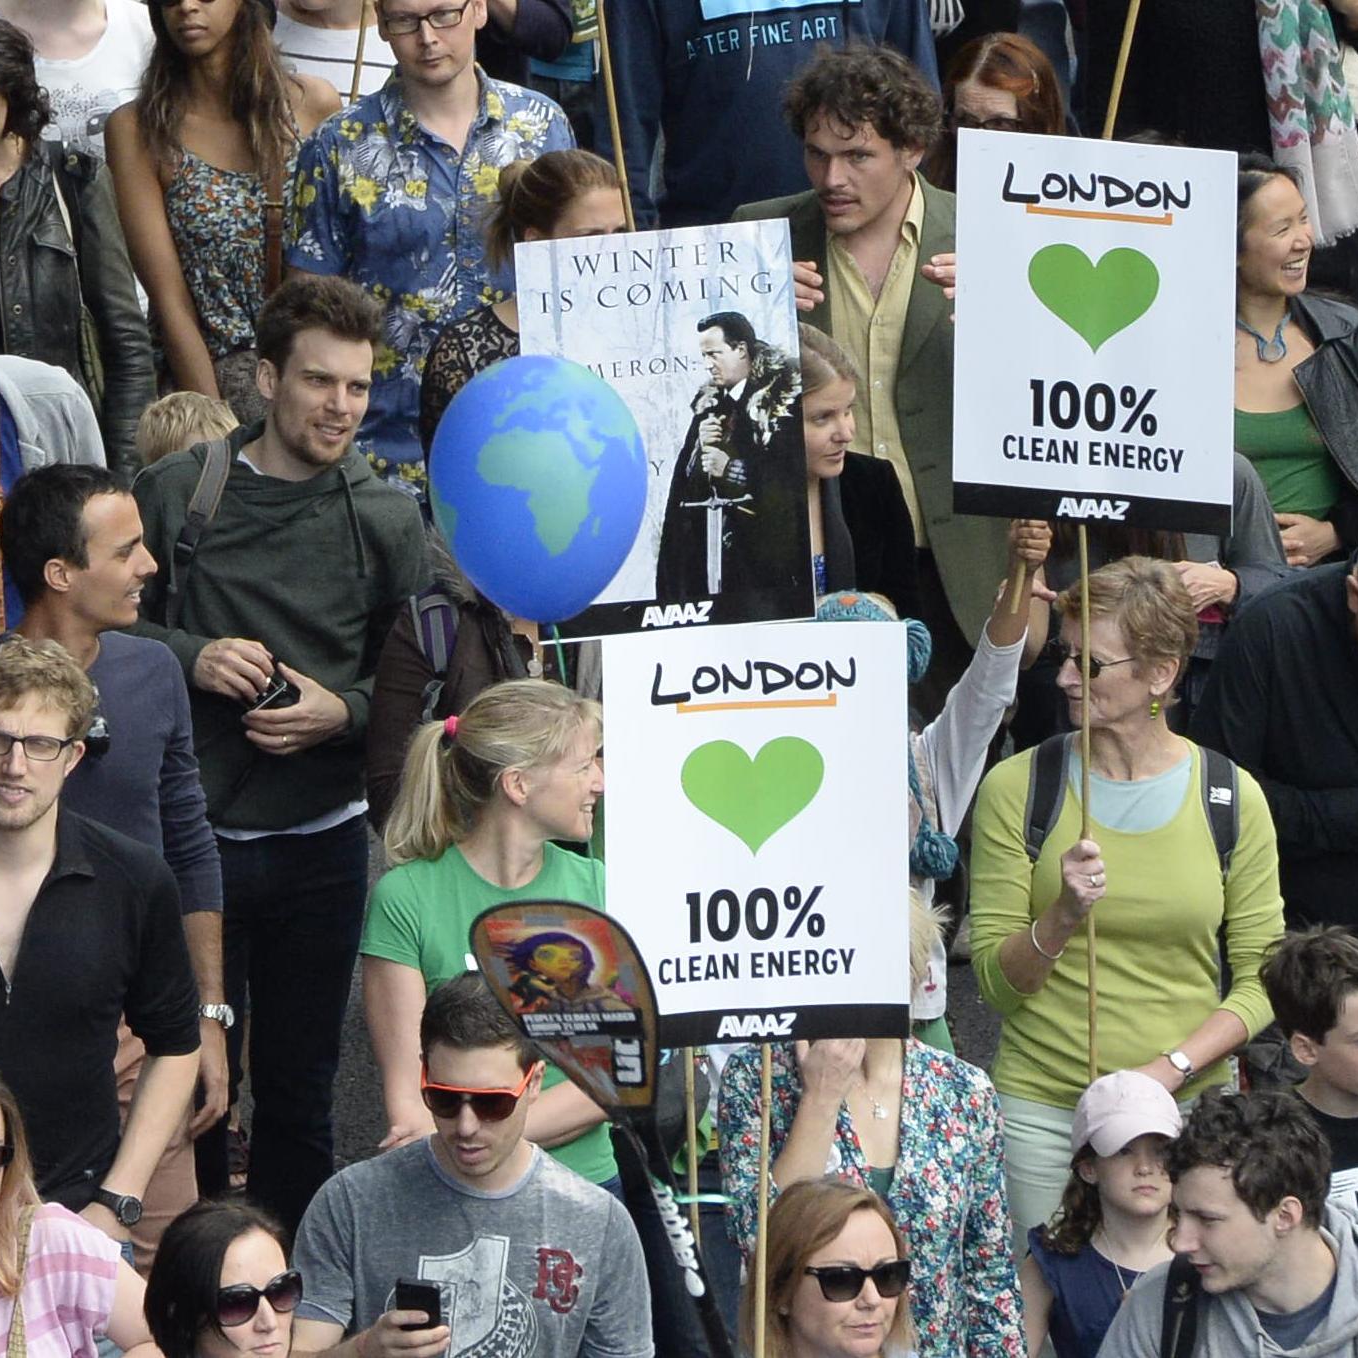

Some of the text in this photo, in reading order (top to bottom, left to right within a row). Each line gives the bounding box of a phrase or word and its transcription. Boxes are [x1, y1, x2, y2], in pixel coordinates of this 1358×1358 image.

[749, 21, 793, 47] FINE
[801, 16, 838, 41] ART
[1002, 162, 1191, 210] LONDON
[572, 241, 738, 277] WINTER
[541, 290, 573, 314] IS
[1030, 379, 1158, 437] 100%
[1003, 435, 1184, 473] CLEAN ENERGY
[1056, 497, 1131, 520] AVAAZ
[641, 600, 713, 627] AVAAZ
[651, 657, 856, 705] LONDON
[686, 885, 825, 943] 100%
[659, 948, 856, 985] CLEAN ENERGY
[717, 1013, 797, 1038] AVAAZ
